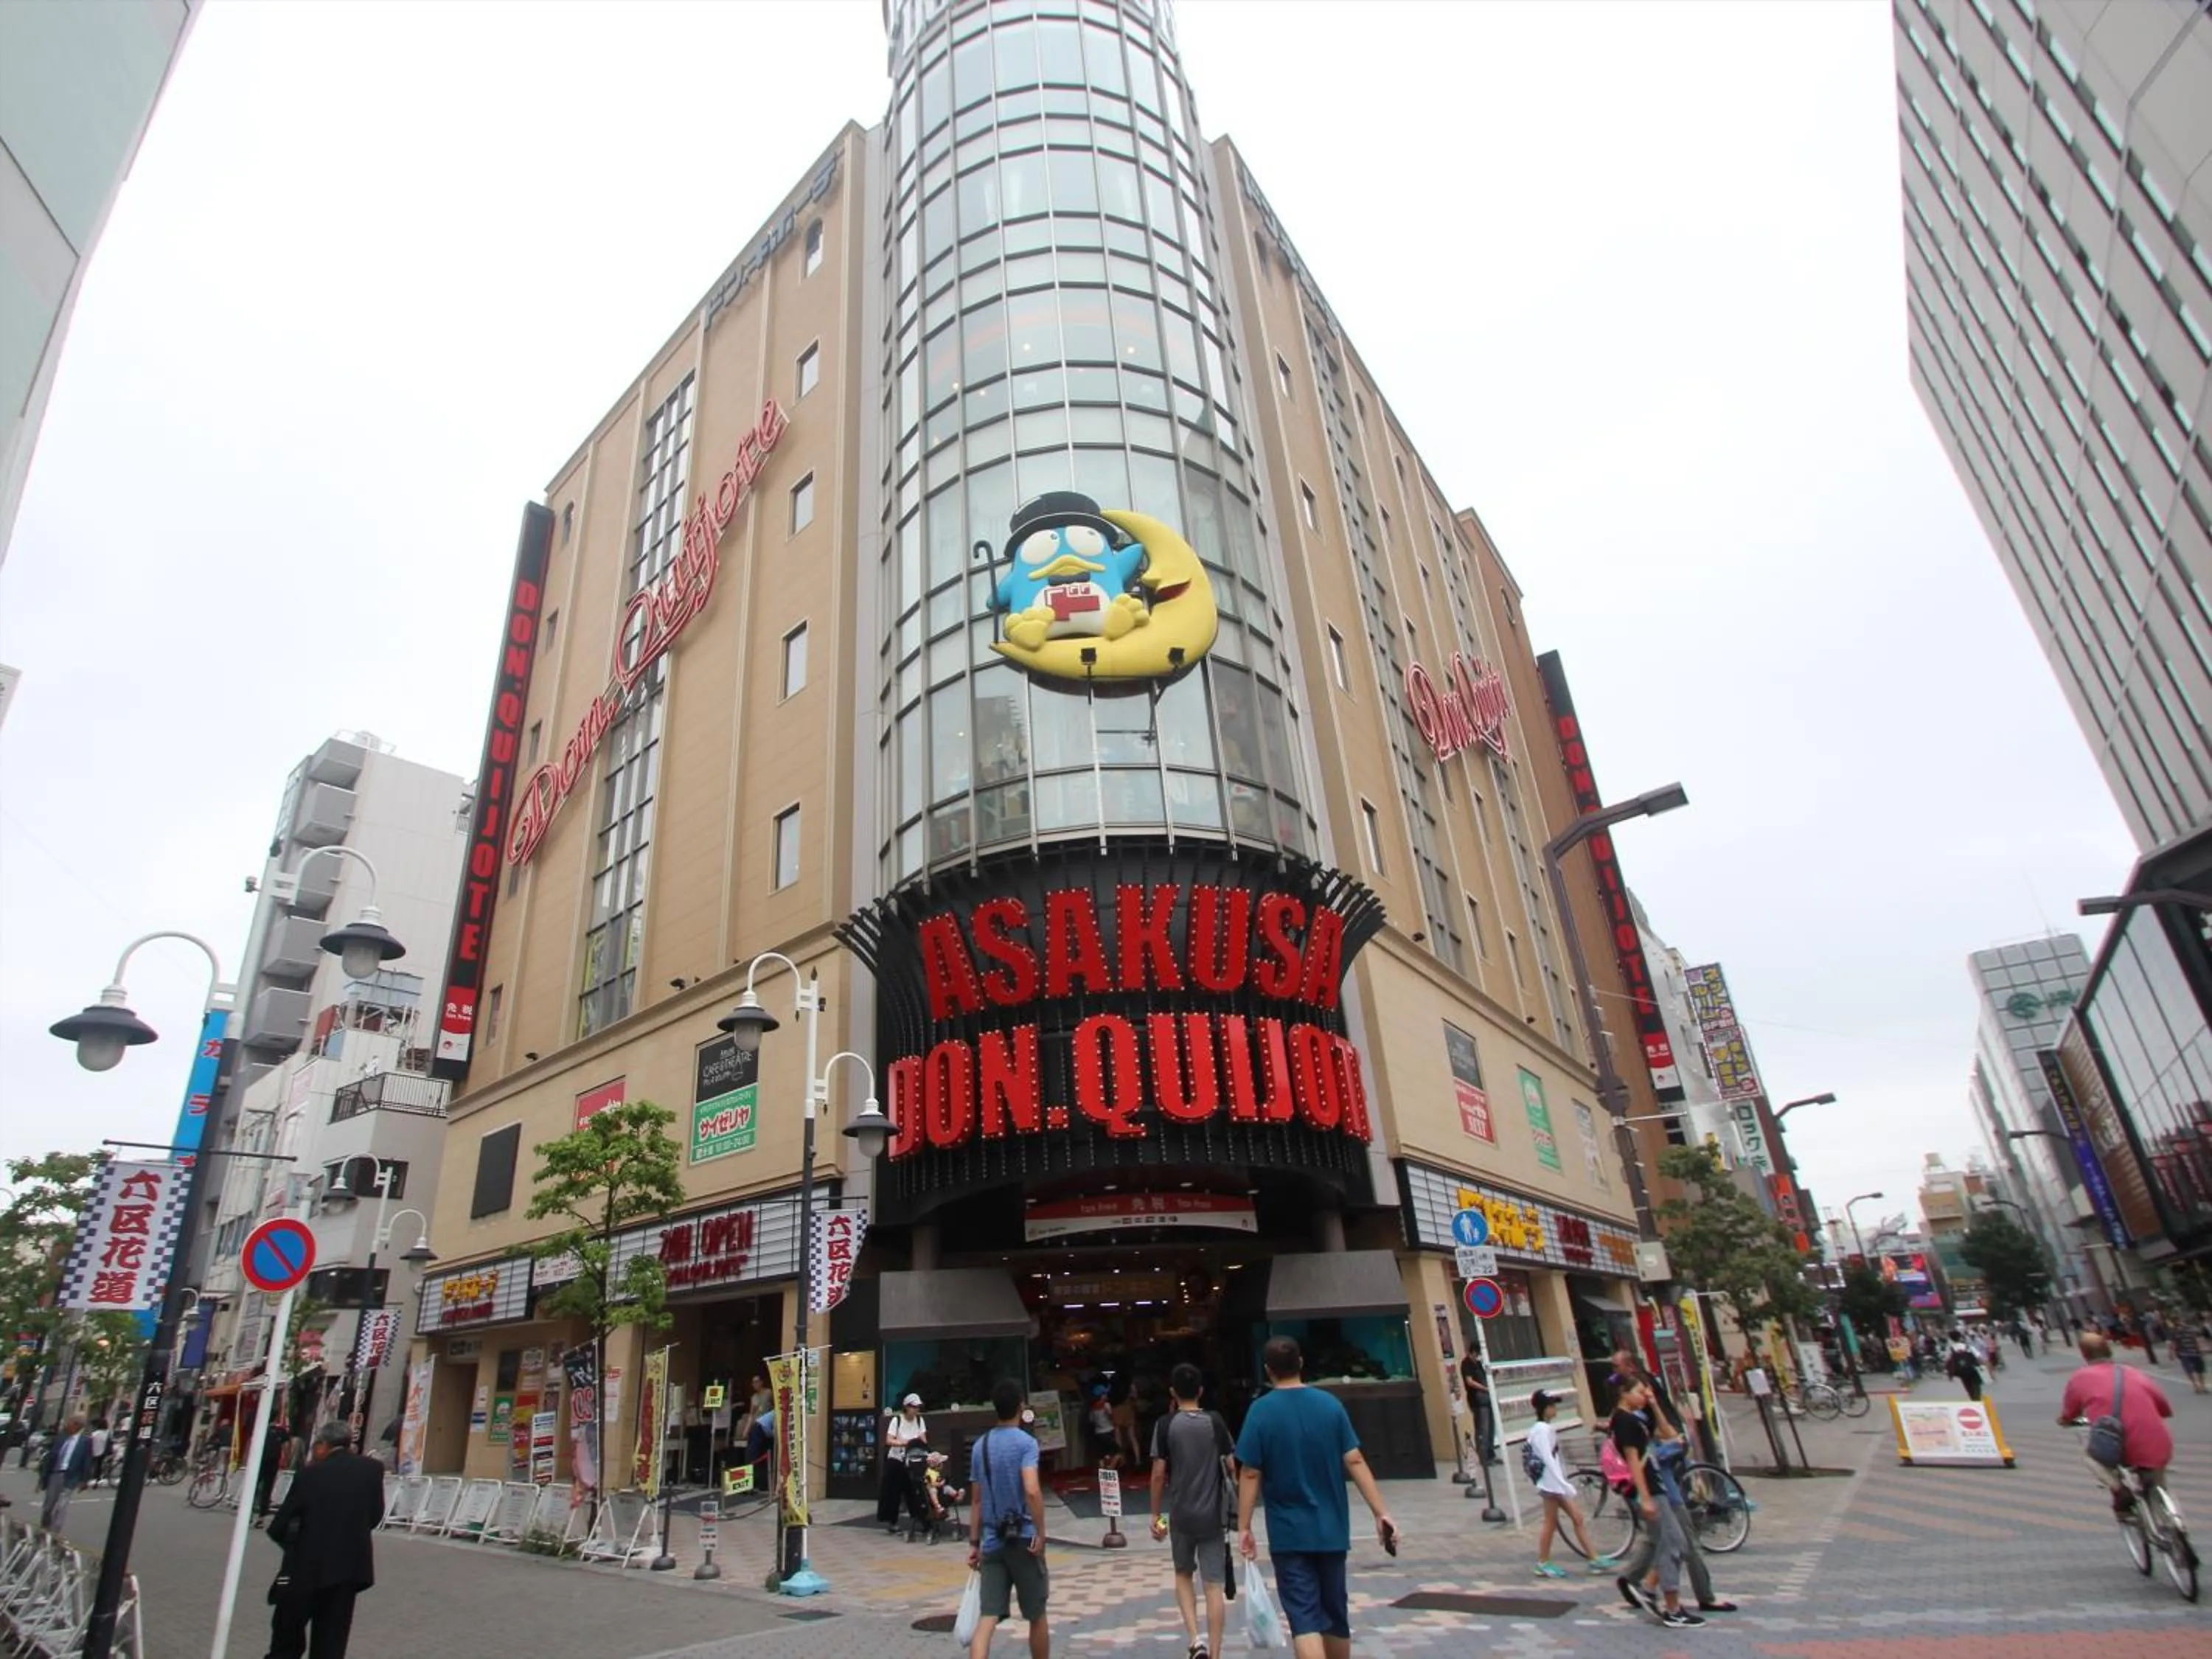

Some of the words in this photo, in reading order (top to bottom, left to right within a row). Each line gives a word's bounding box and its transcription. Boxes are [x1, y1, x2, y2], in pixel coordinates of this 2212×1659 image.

[1558, 715, 1654, 1015] DON.UIJOTE
[917, 884, 1344, 1022] ASAKUSA
[699, 1107, 751, 1139] サイゼリヤ
[87, 1169, 162, 1304] 六区花道
